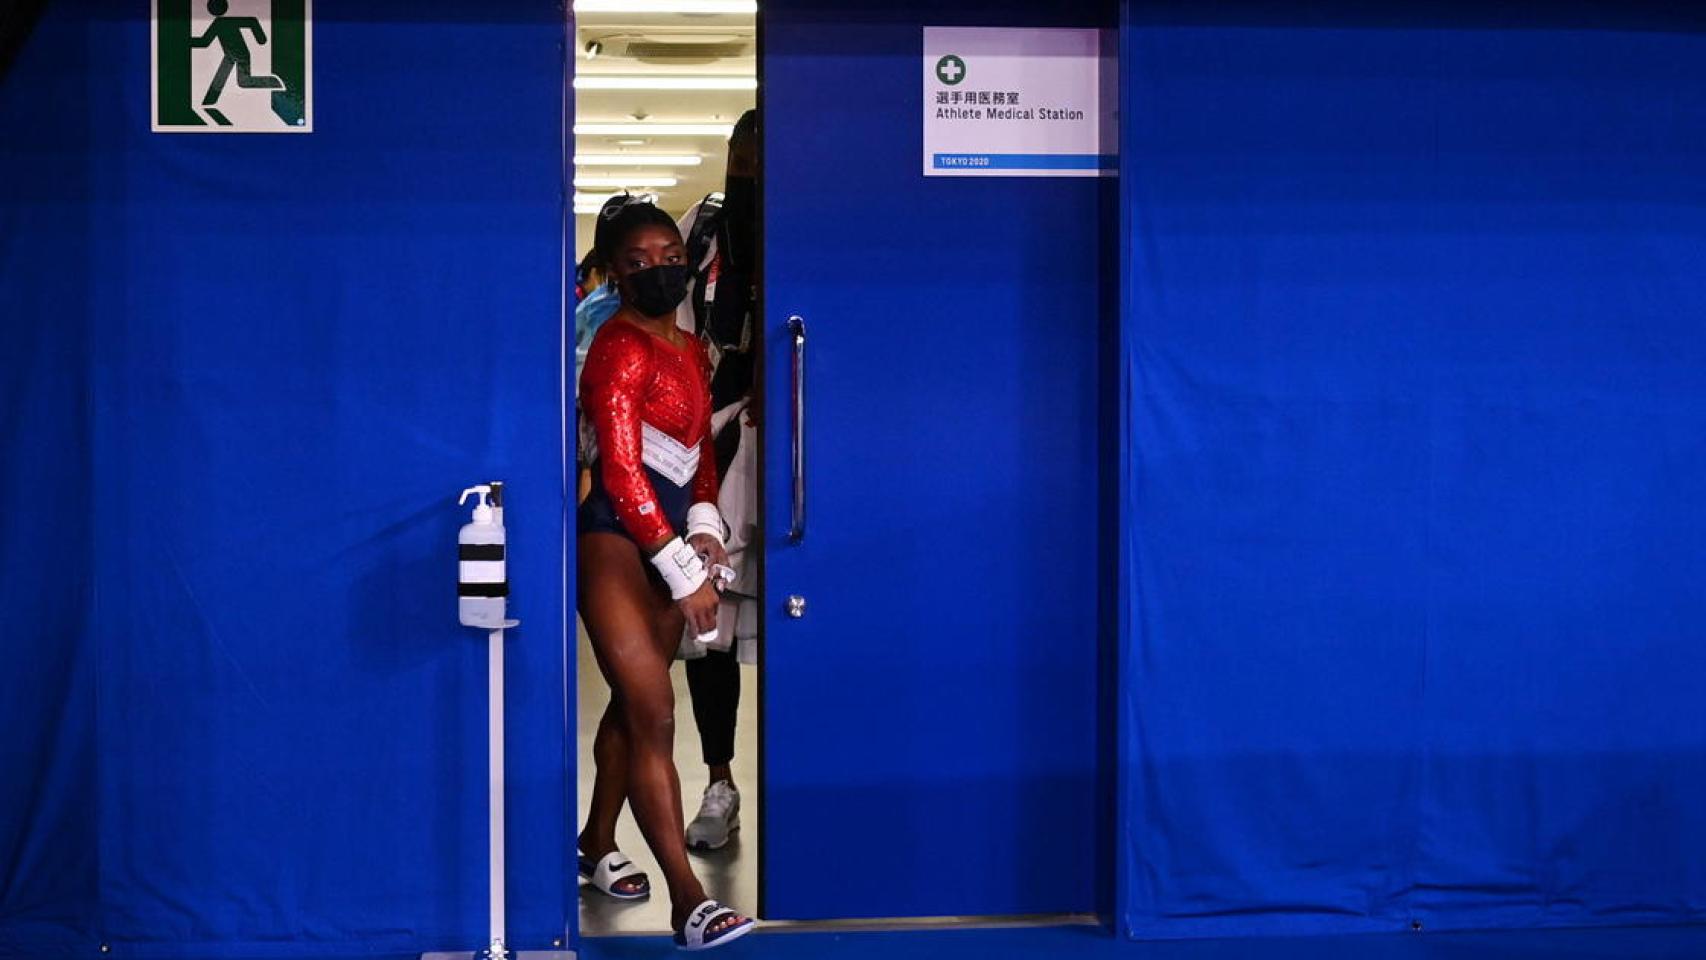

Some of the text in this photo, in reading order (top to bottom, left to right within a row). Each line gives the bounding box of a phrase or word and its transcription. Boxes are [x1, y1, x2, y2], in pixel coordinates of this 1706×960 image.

[936, 91, 1019, 105] 選手用医務室
[936, 107, 1084, 121] Athlete Medical Station
